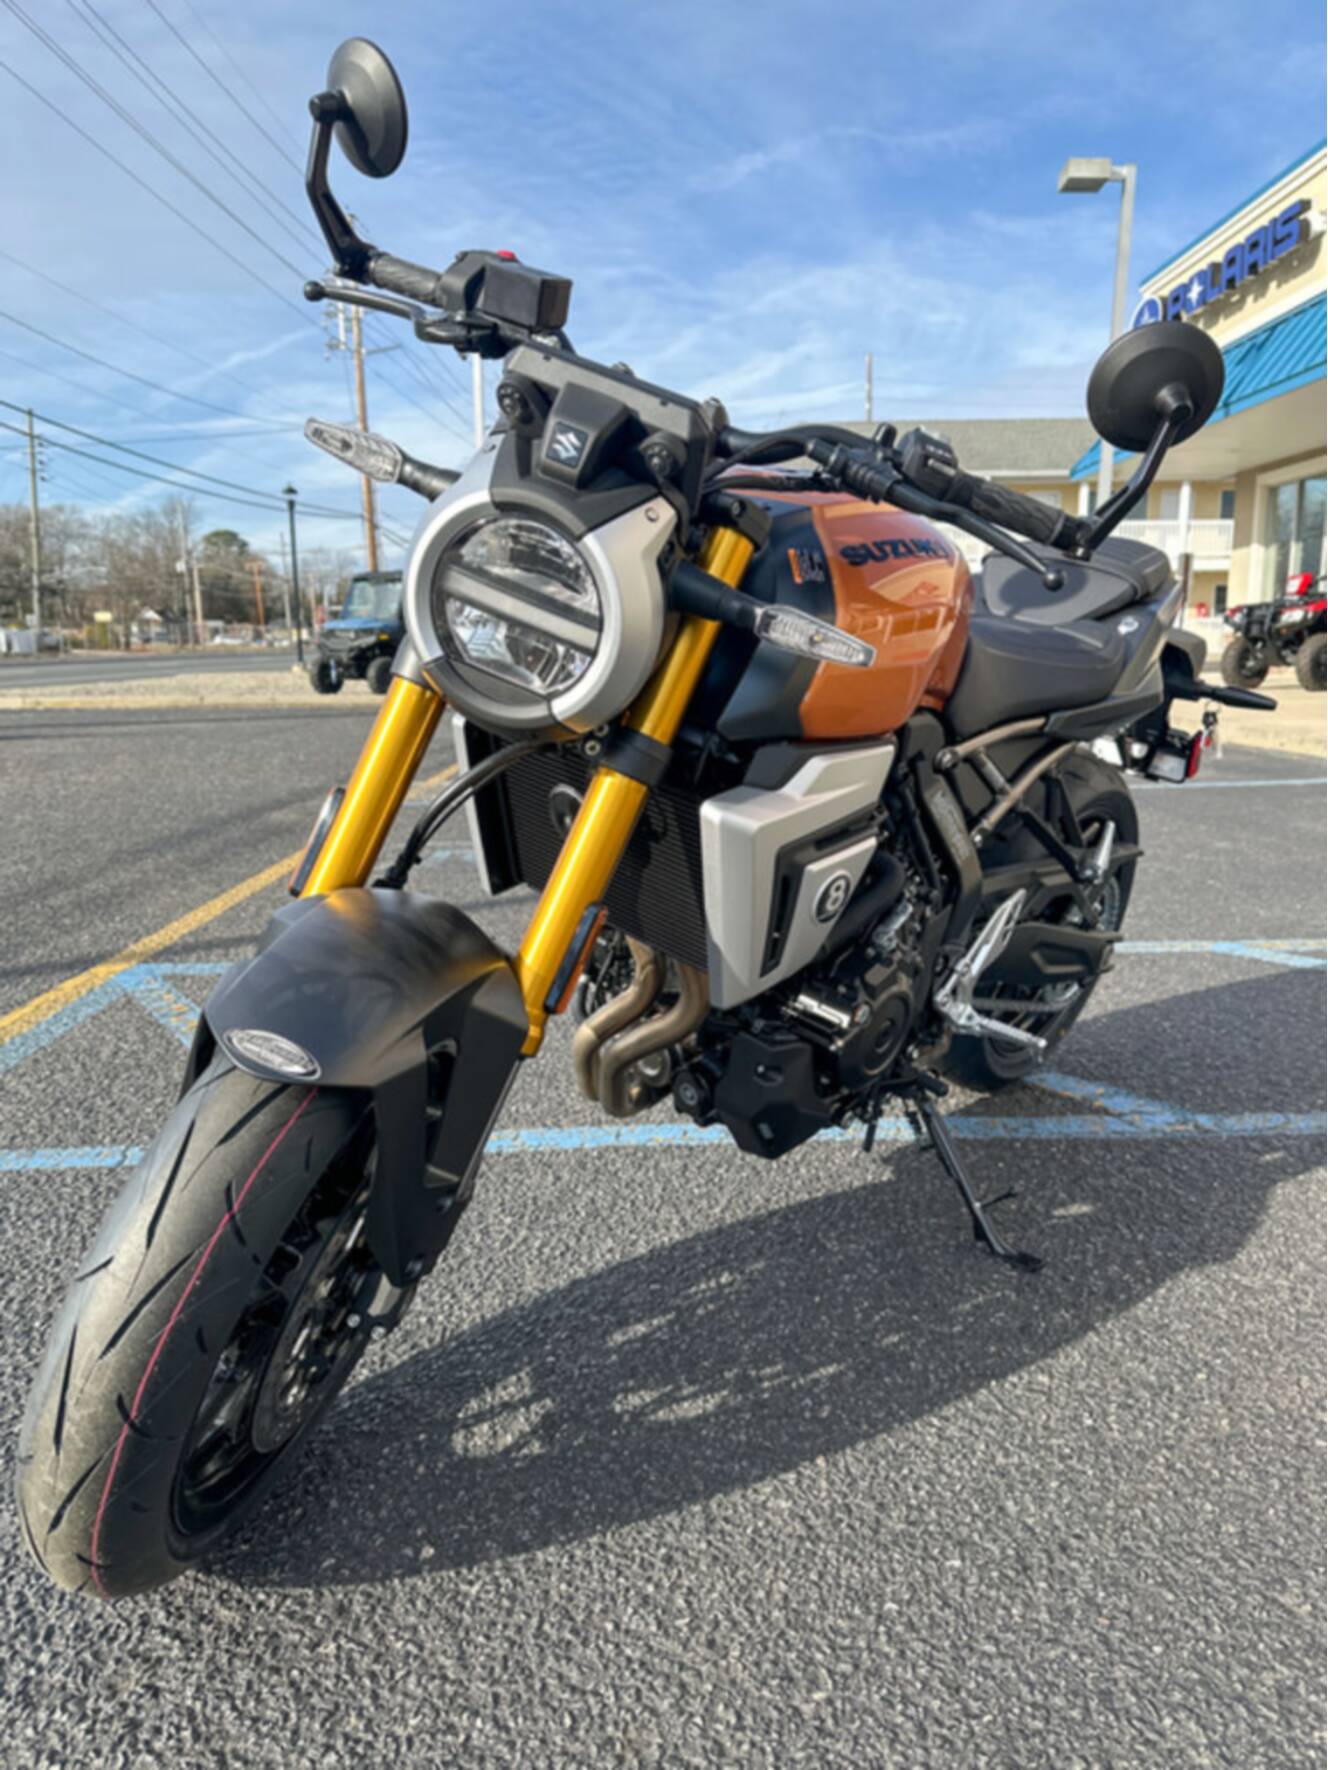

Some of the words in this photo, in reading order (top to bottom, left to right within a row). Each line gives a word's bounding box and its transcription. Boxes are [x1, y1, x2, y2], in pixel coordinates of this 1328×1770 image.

[1166, 199, 1310, 320] POLARIS
[840, 539, 949, 566] SUZUKI
[826, 879, 846, 911] 8
